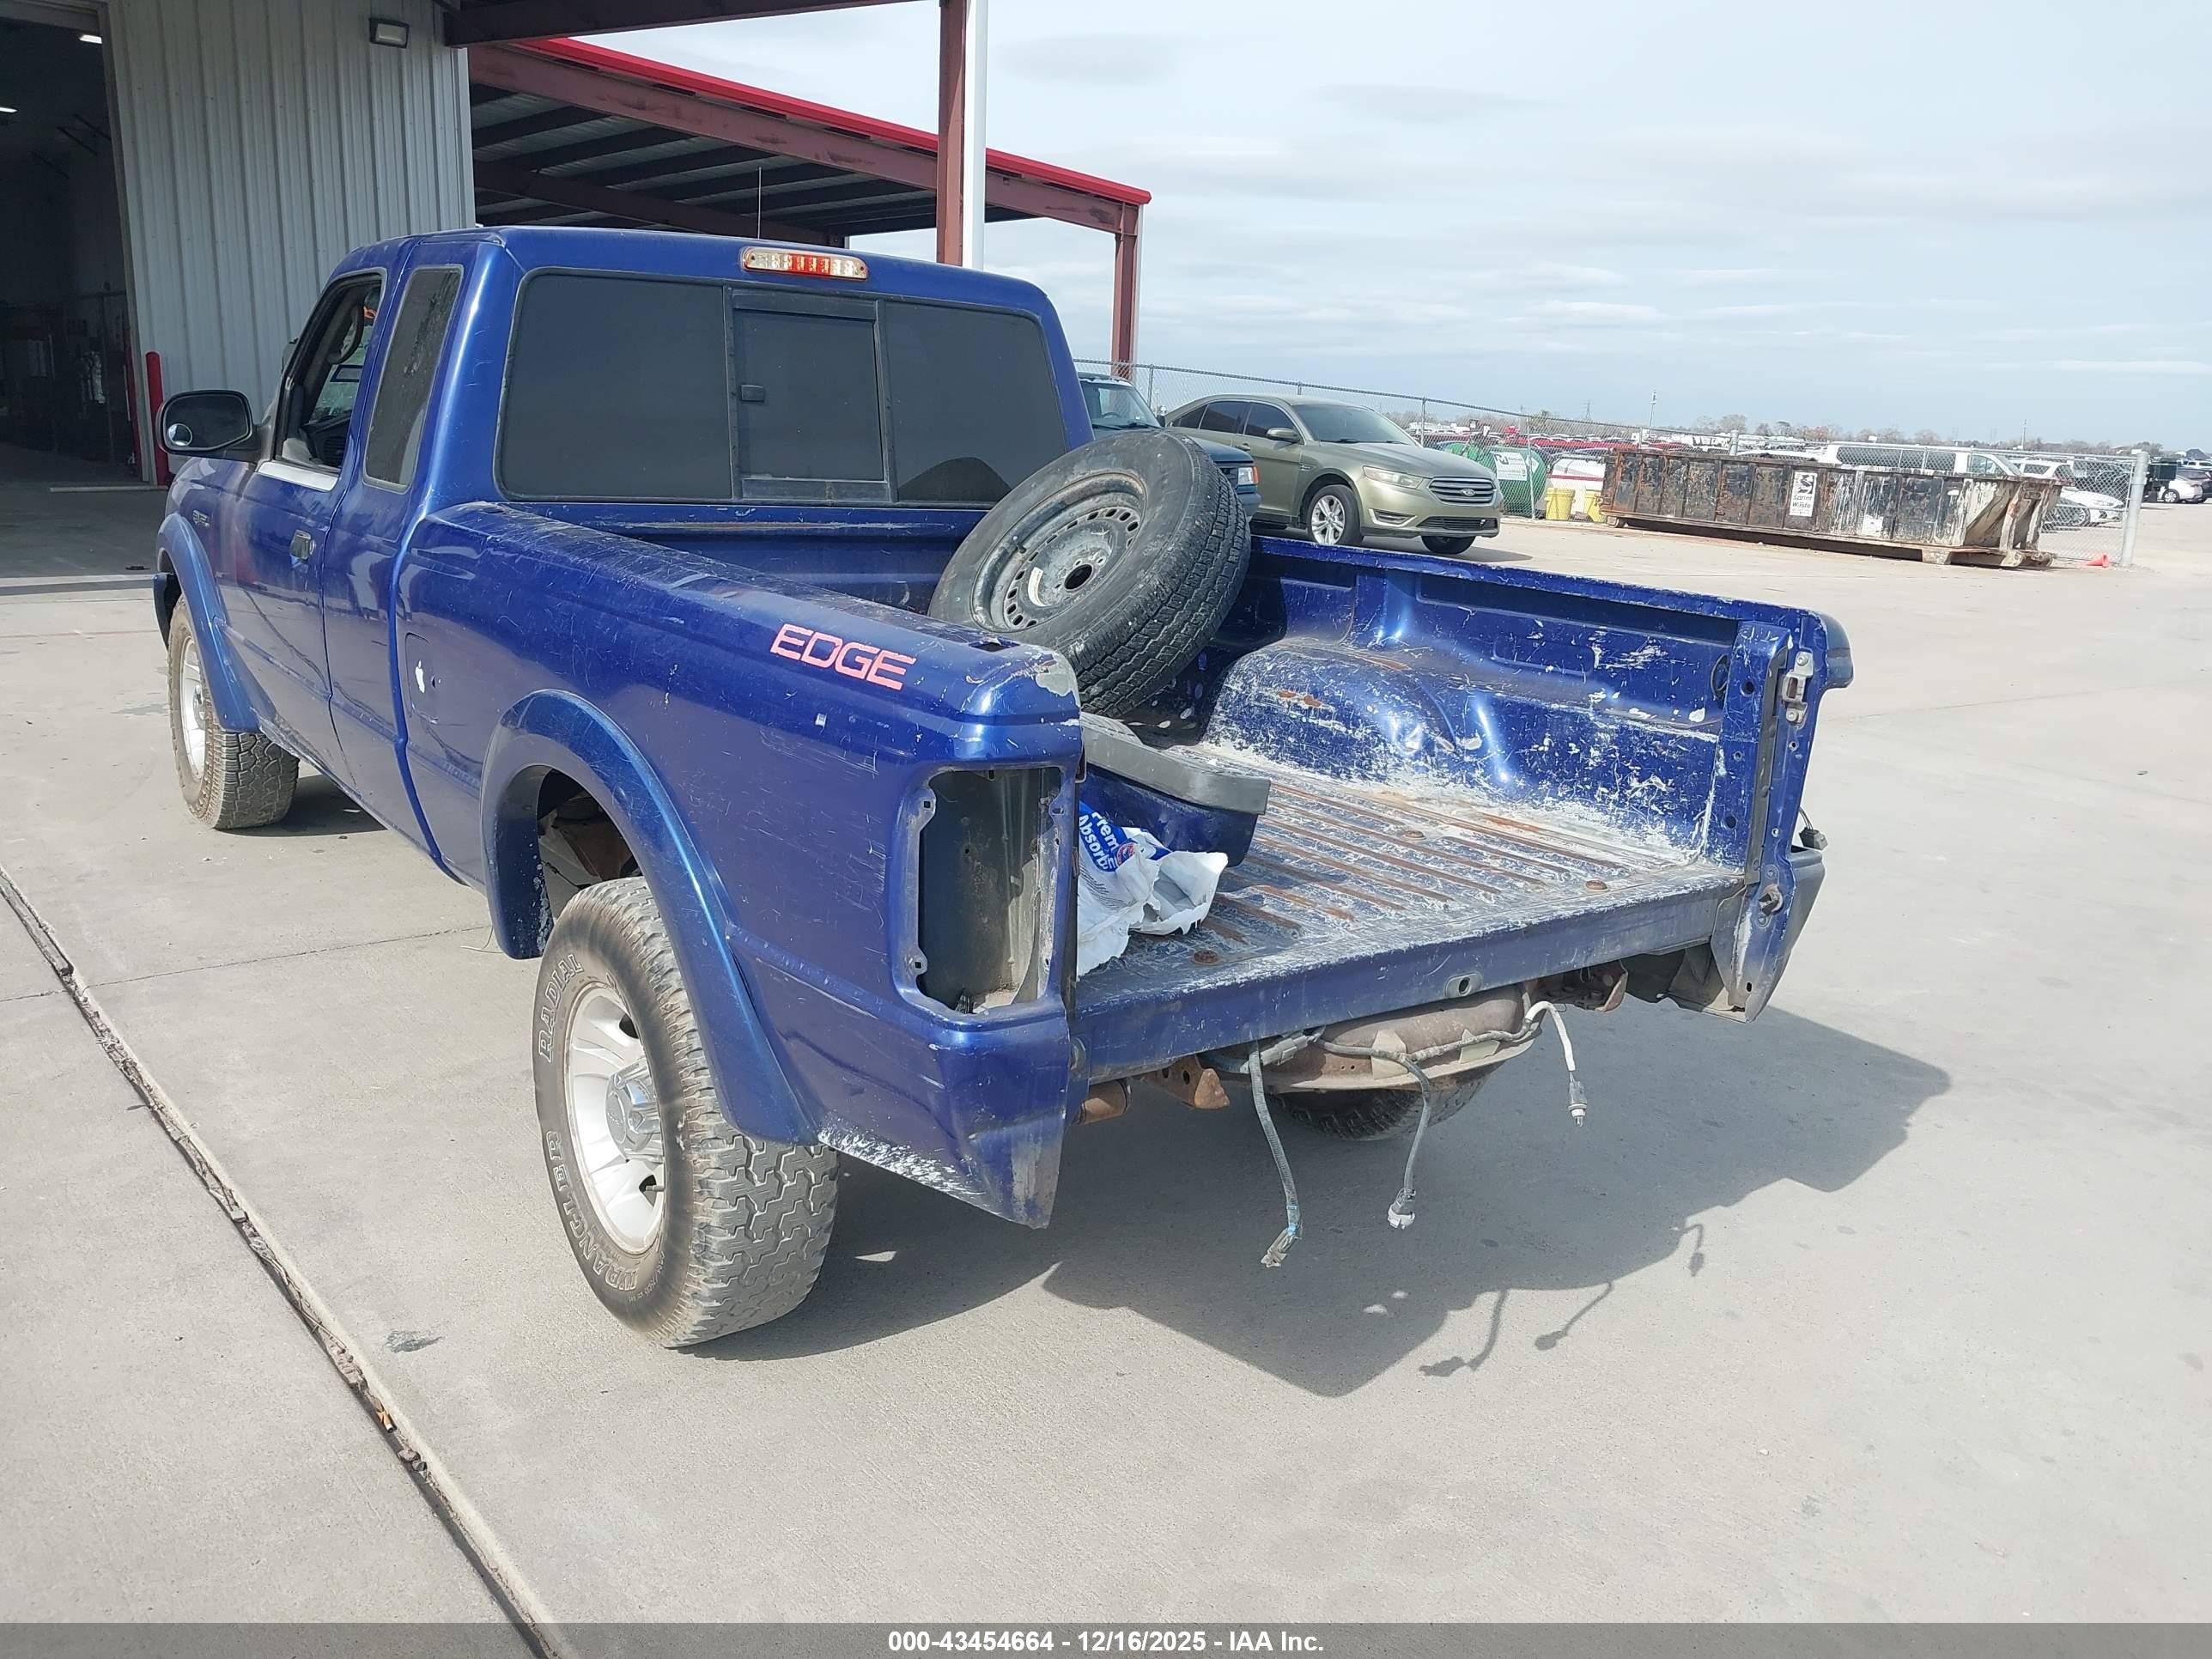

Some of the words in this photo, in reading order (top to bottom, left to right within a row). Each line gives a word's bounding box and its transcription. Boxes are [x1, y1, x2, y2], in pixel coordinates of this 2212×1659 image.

[769, 623, 917, 690] EDGE
[538, 953, 585, 1063] RADIAL
[546, 1130, 639, 1291] WRANGLER
